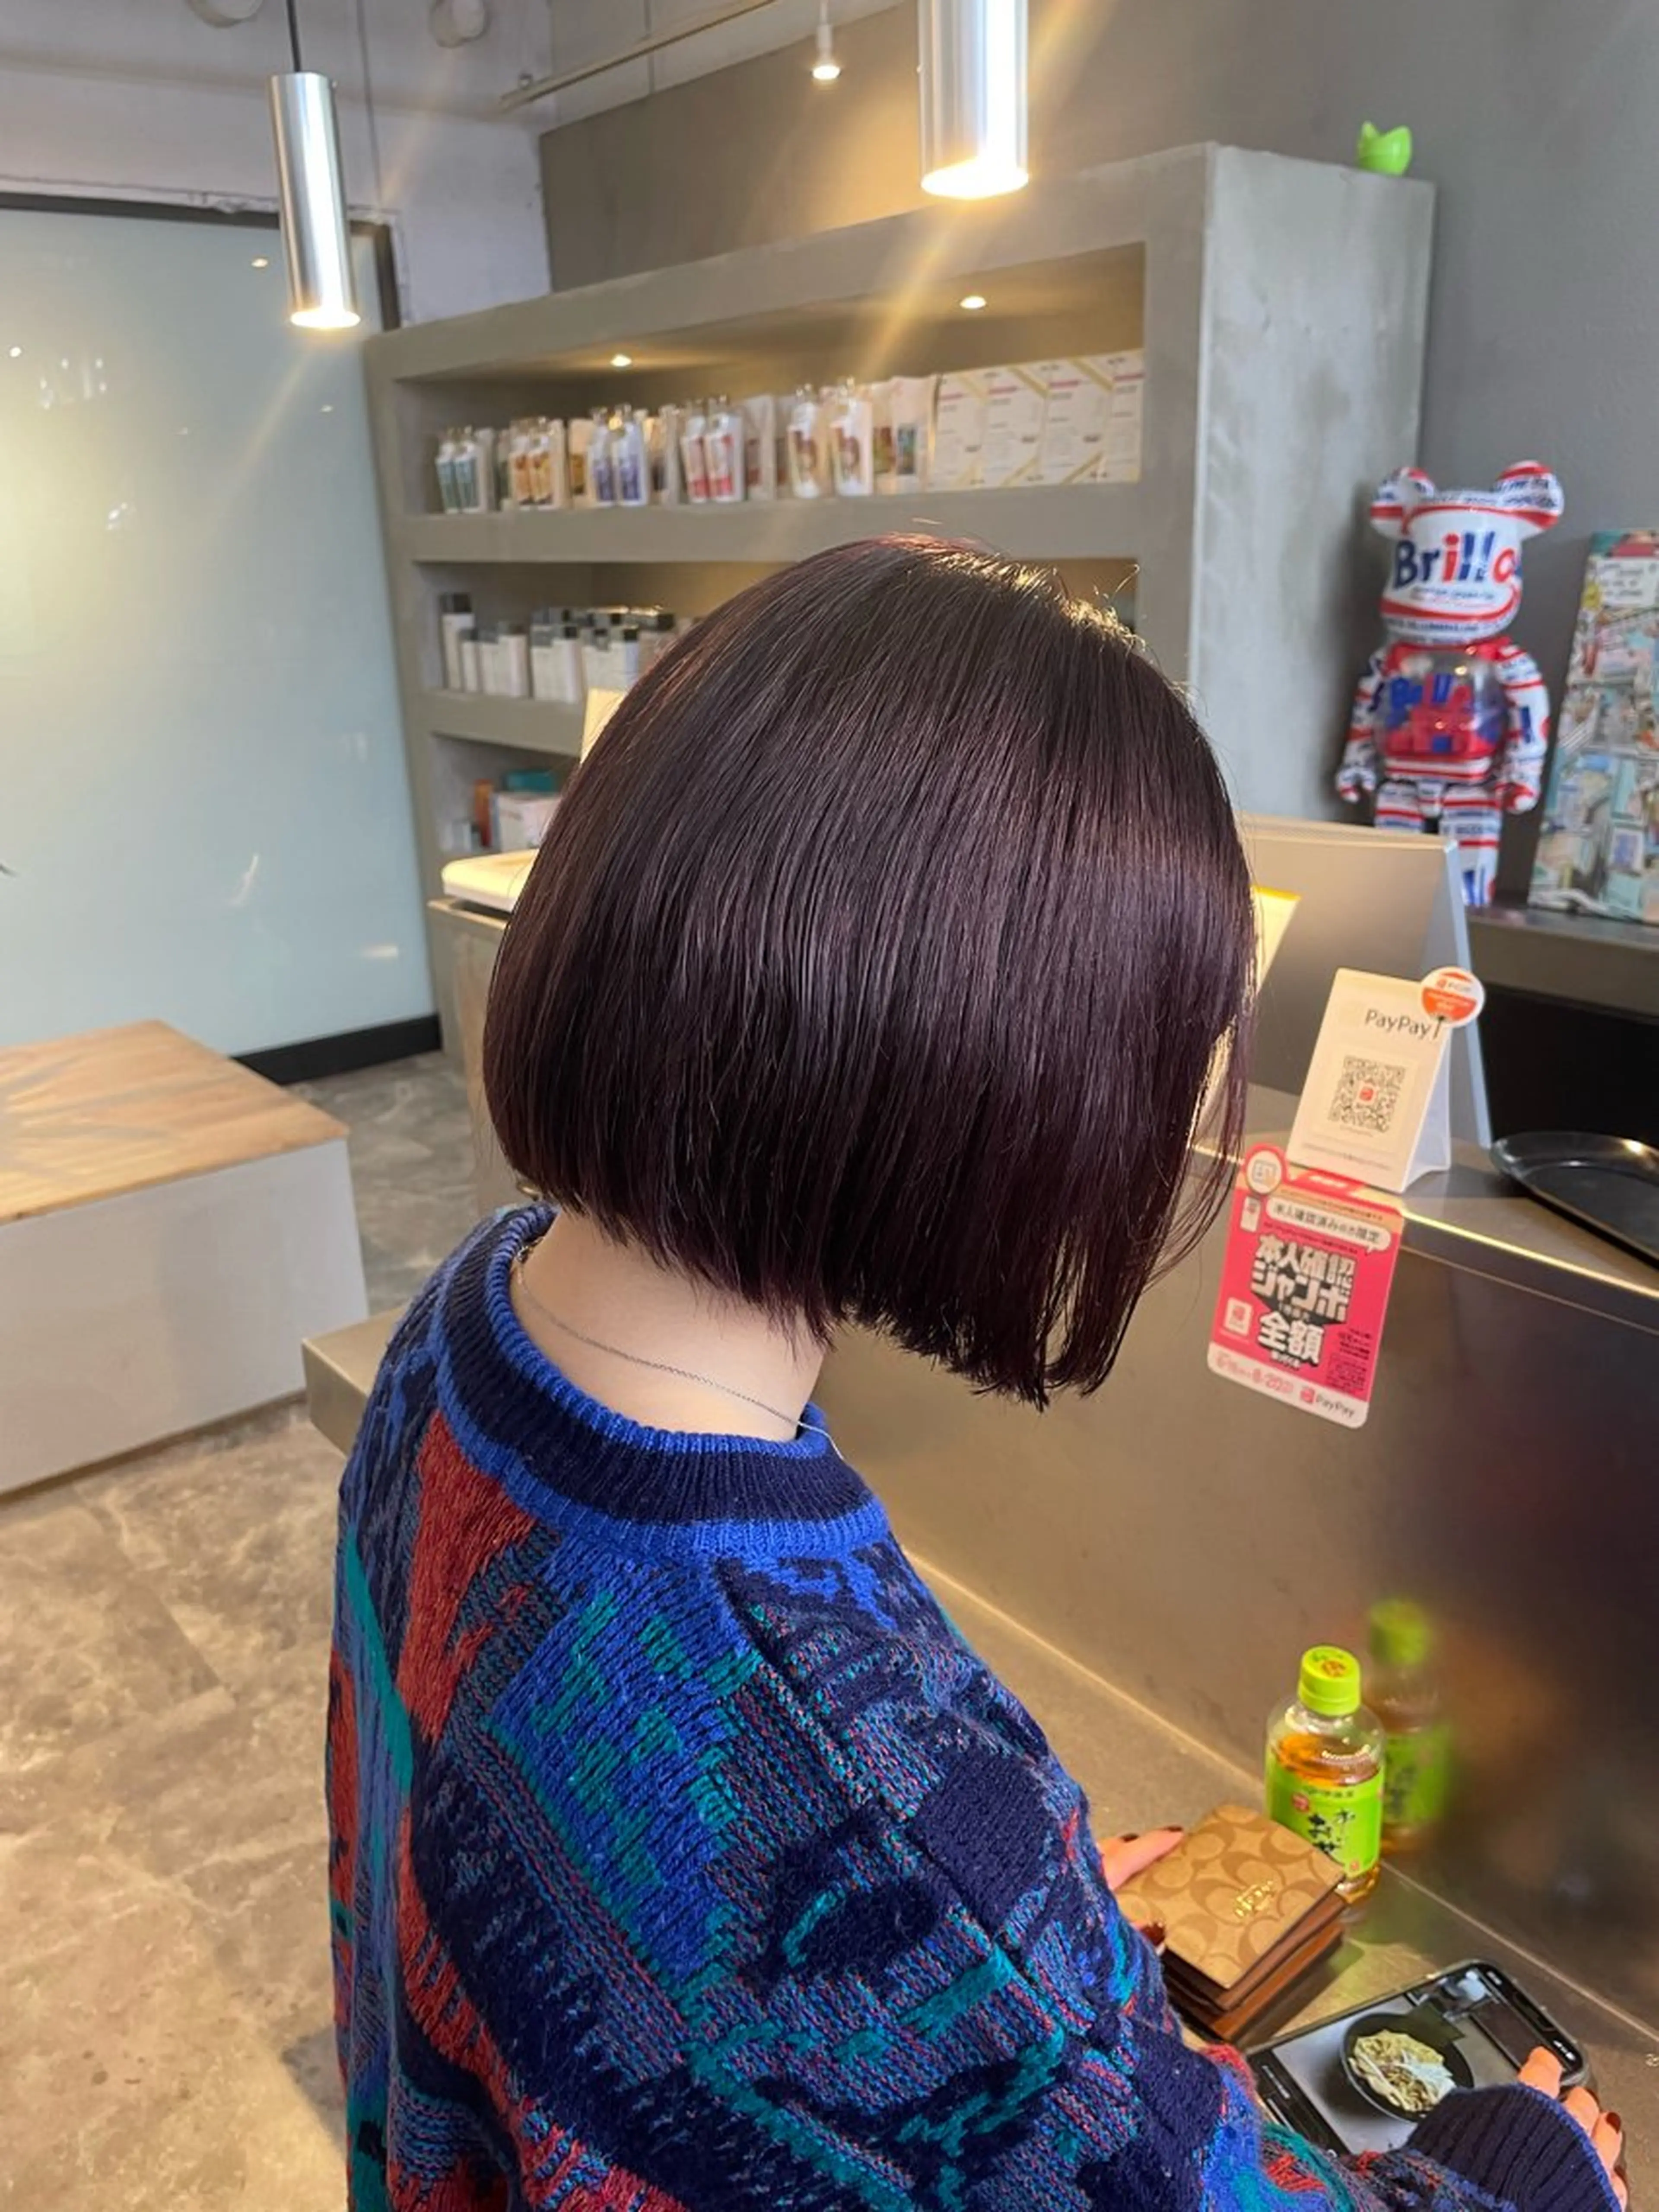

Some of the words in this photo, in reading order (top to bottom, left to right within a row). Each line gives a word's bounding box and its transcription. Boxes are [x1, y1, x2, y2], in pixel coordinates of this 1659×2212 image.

[1365, 1009, 1432, 1039] PayPay
[1255, 1233, 1356, 1285] 本人確認
[1251, 1259, 1353, 1321] ジャンボ
[1257, 1311, 1324, 1365] 全額
[1316, 1394, 1355, 1418] PayPay
